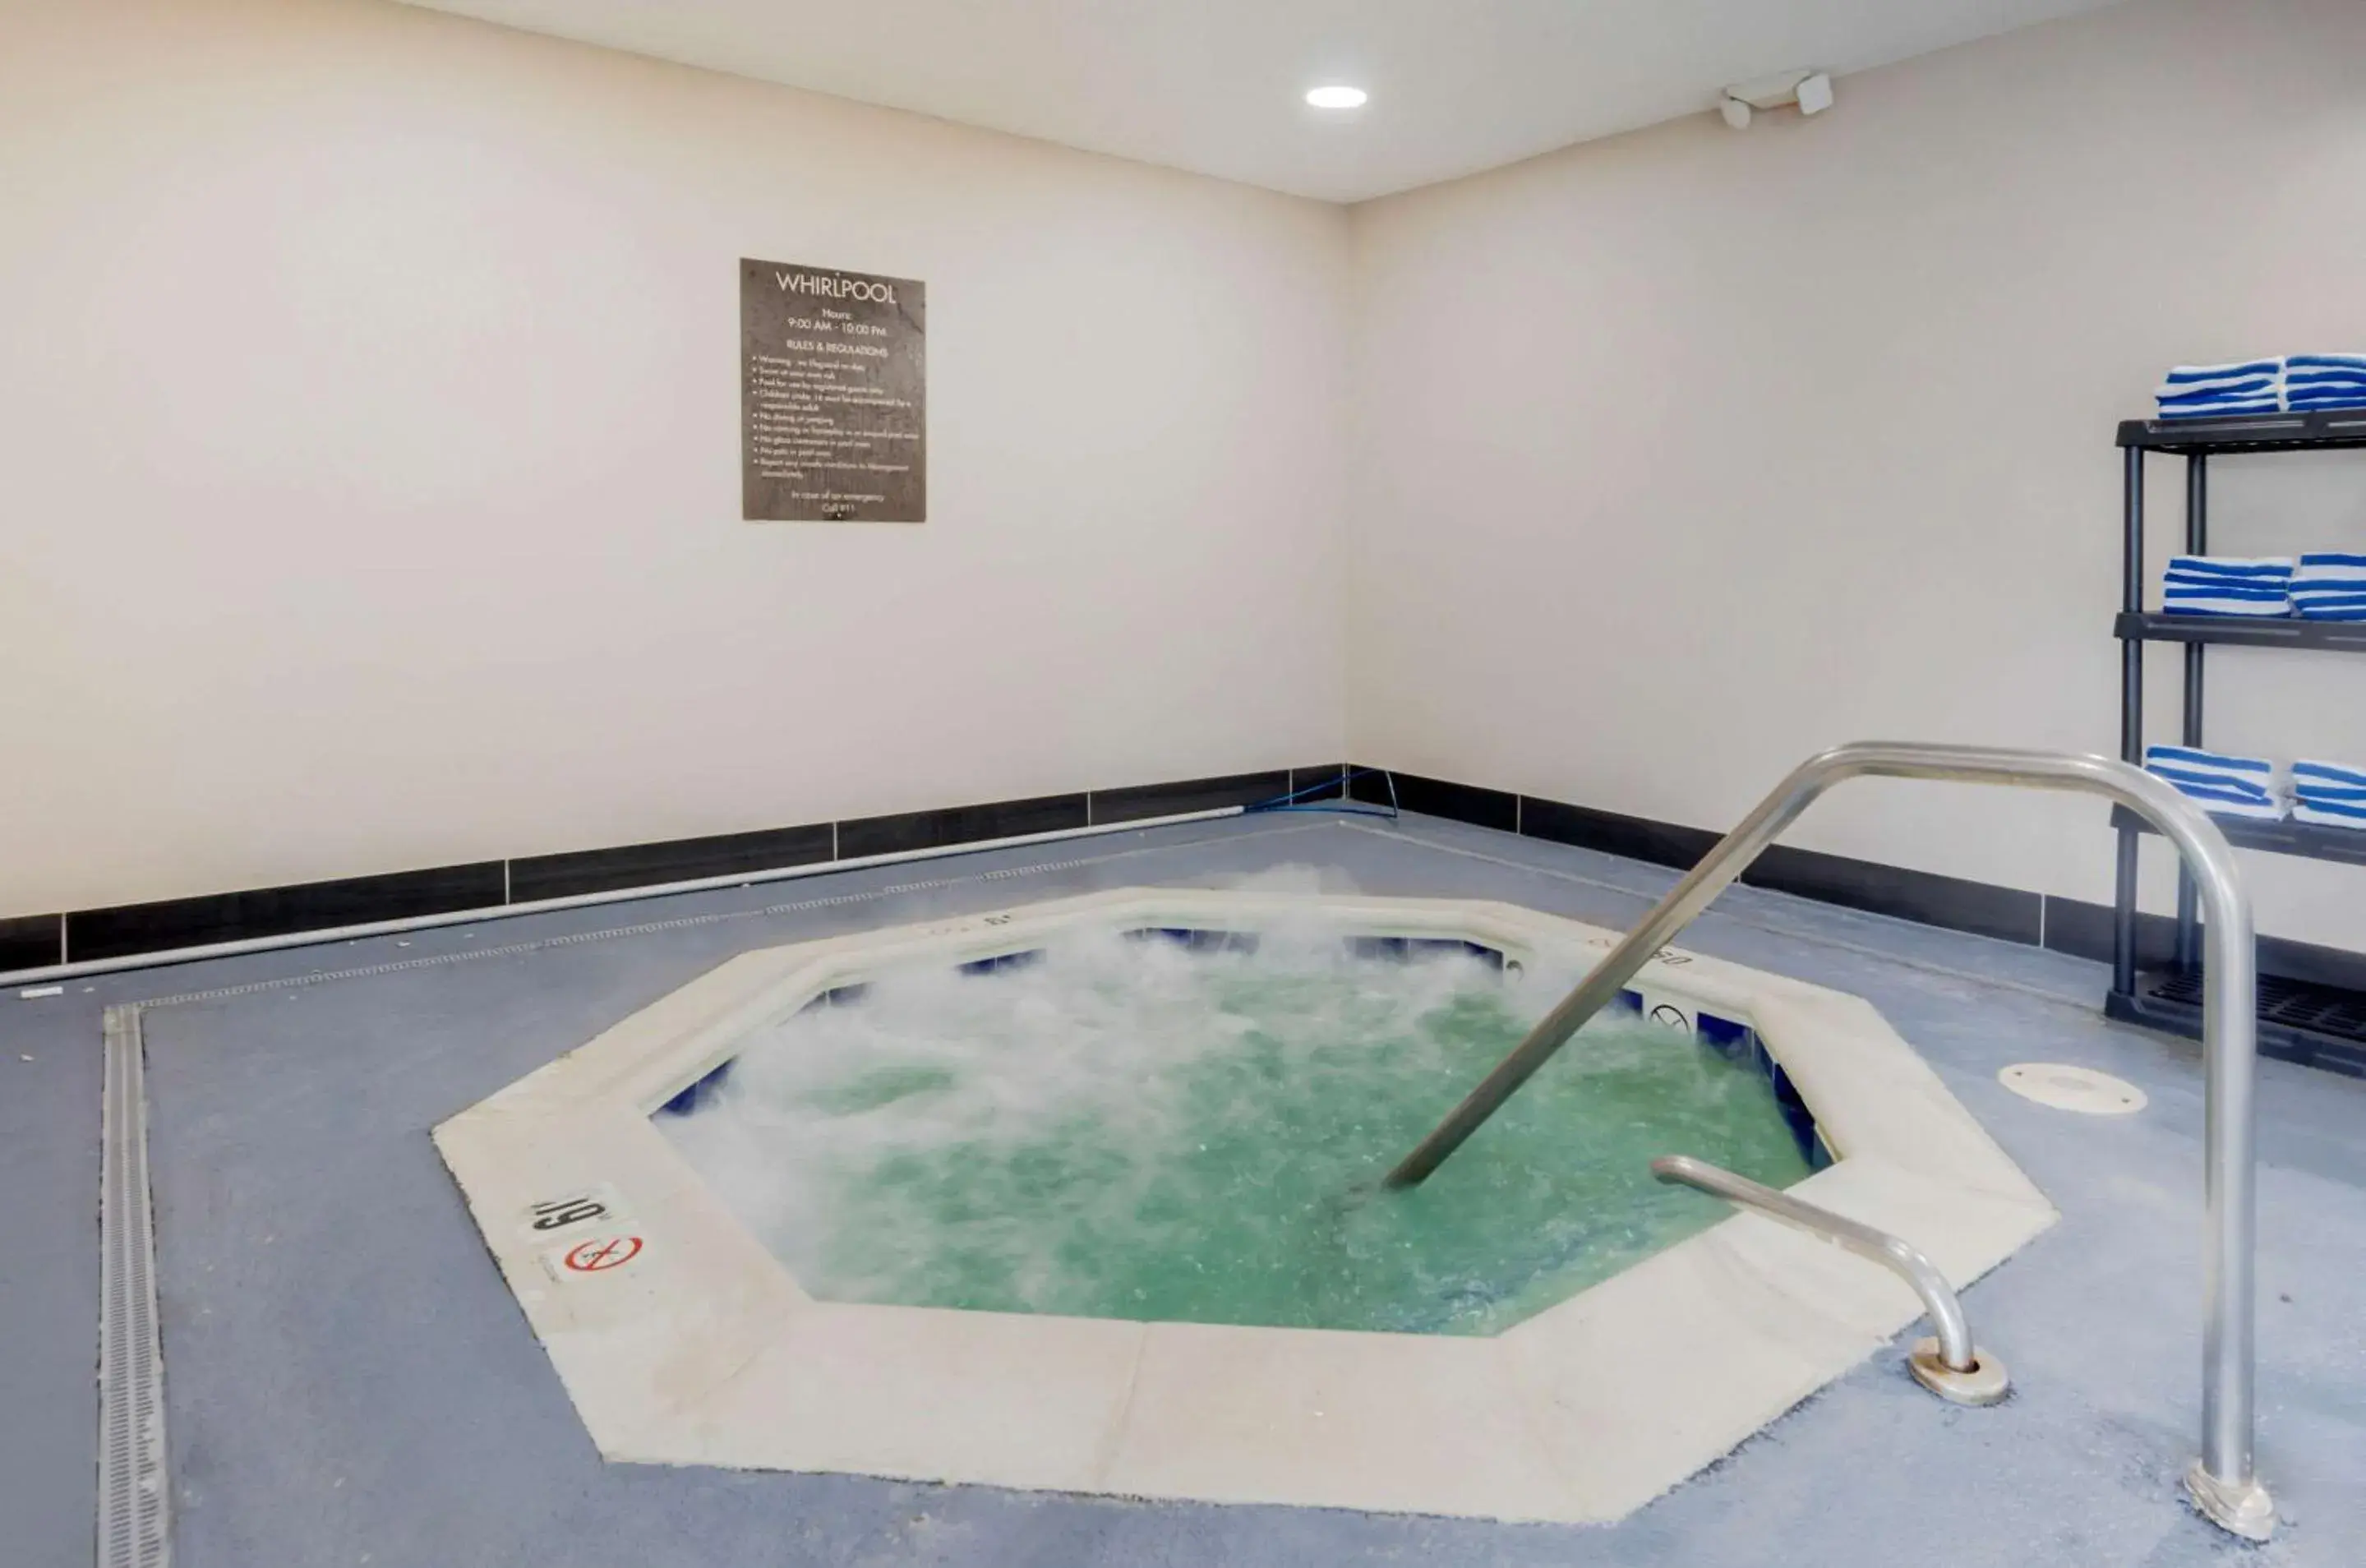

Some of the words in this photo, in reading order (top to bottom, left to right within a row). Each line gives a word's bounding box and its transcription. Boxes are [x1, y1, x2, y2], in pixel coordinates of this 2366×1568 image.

[775, 271, 897, 303] WHIRLPOOL
[788, 317, 811, 329] 9:00
[814, 320, 832, 333] AM
[786, 339, 814, 350] RULES
[816, 342, 823, 352] &
[826, 343, 888, 358] REGULATIONS
[822, 502, 838, 513] Call
